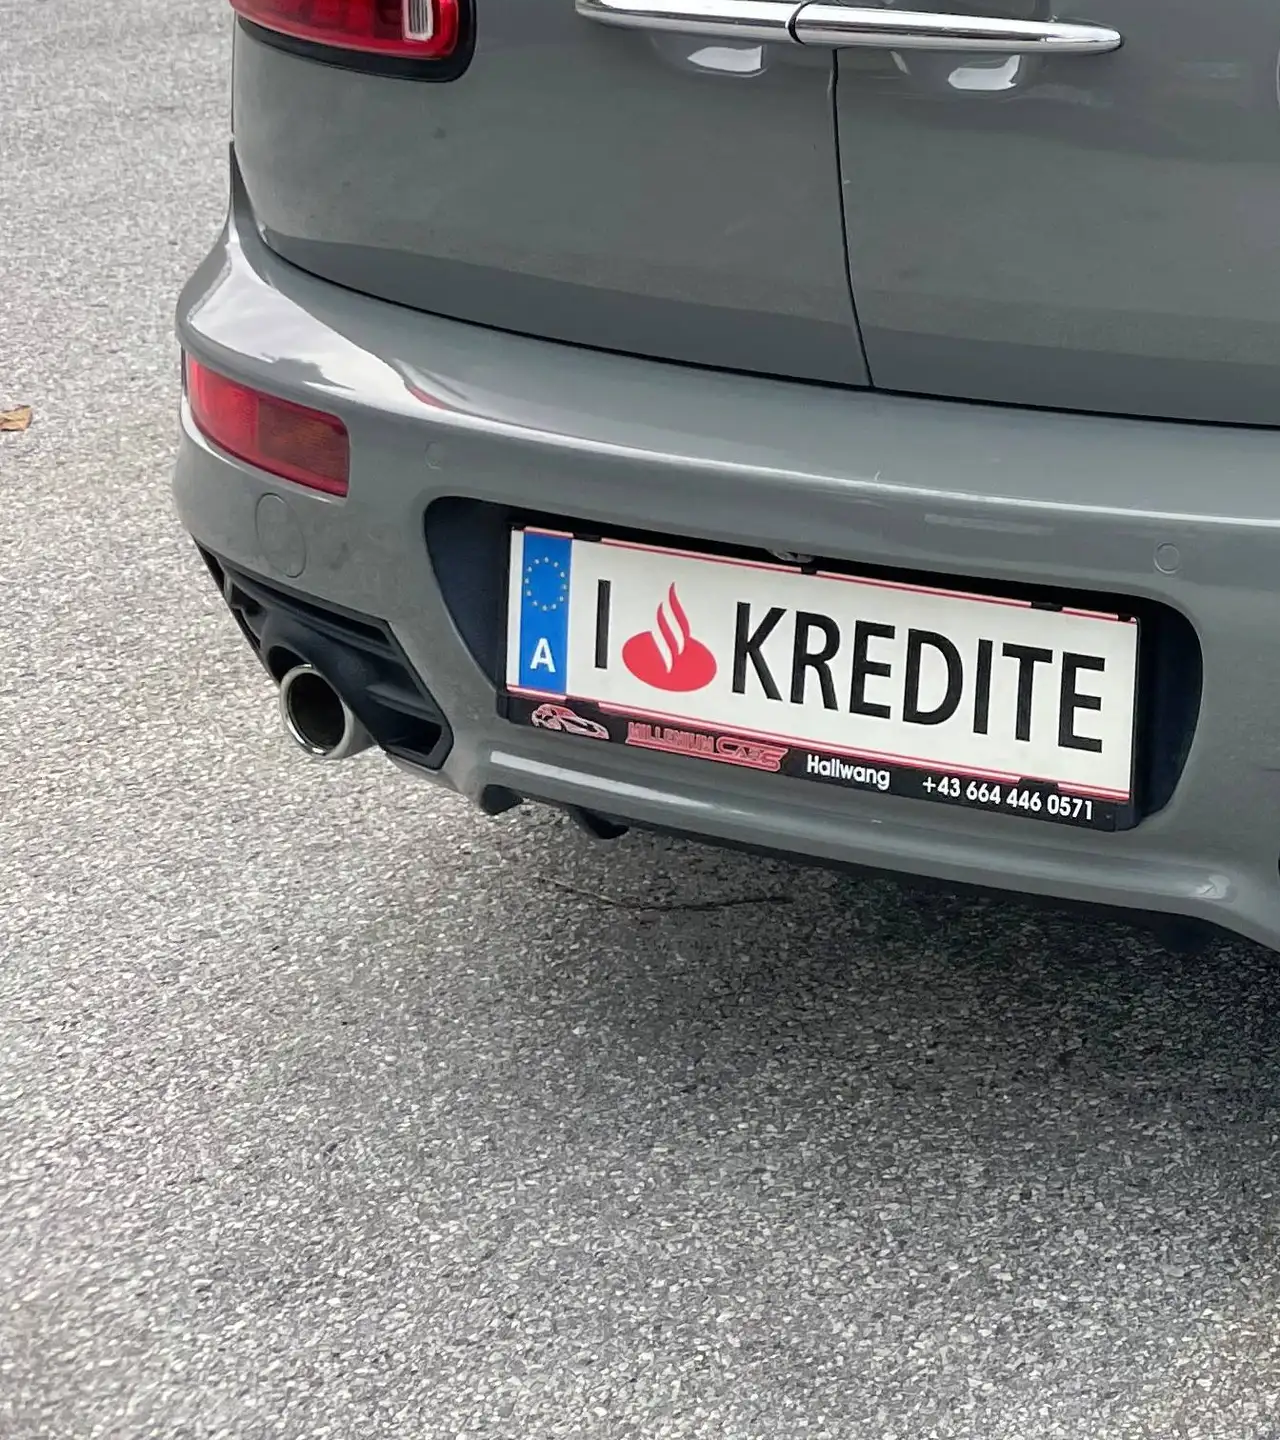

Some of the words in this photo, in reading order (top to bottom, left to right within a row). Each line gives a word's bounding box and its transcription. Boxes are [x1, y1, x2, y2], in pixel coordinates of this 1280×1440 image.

[530, 637, 556, 673] A
[594, 578, 612, 670] I
[731, 601, 1106, 753] KREDITE
[806, 753, 891, 790] Hallwang
[922, 776, 961, 798] +43
[965, 781, 1002, 805] 664
[1005, 787, 1042, 812] 446
[1047, 793, 1093, 820] 0571
